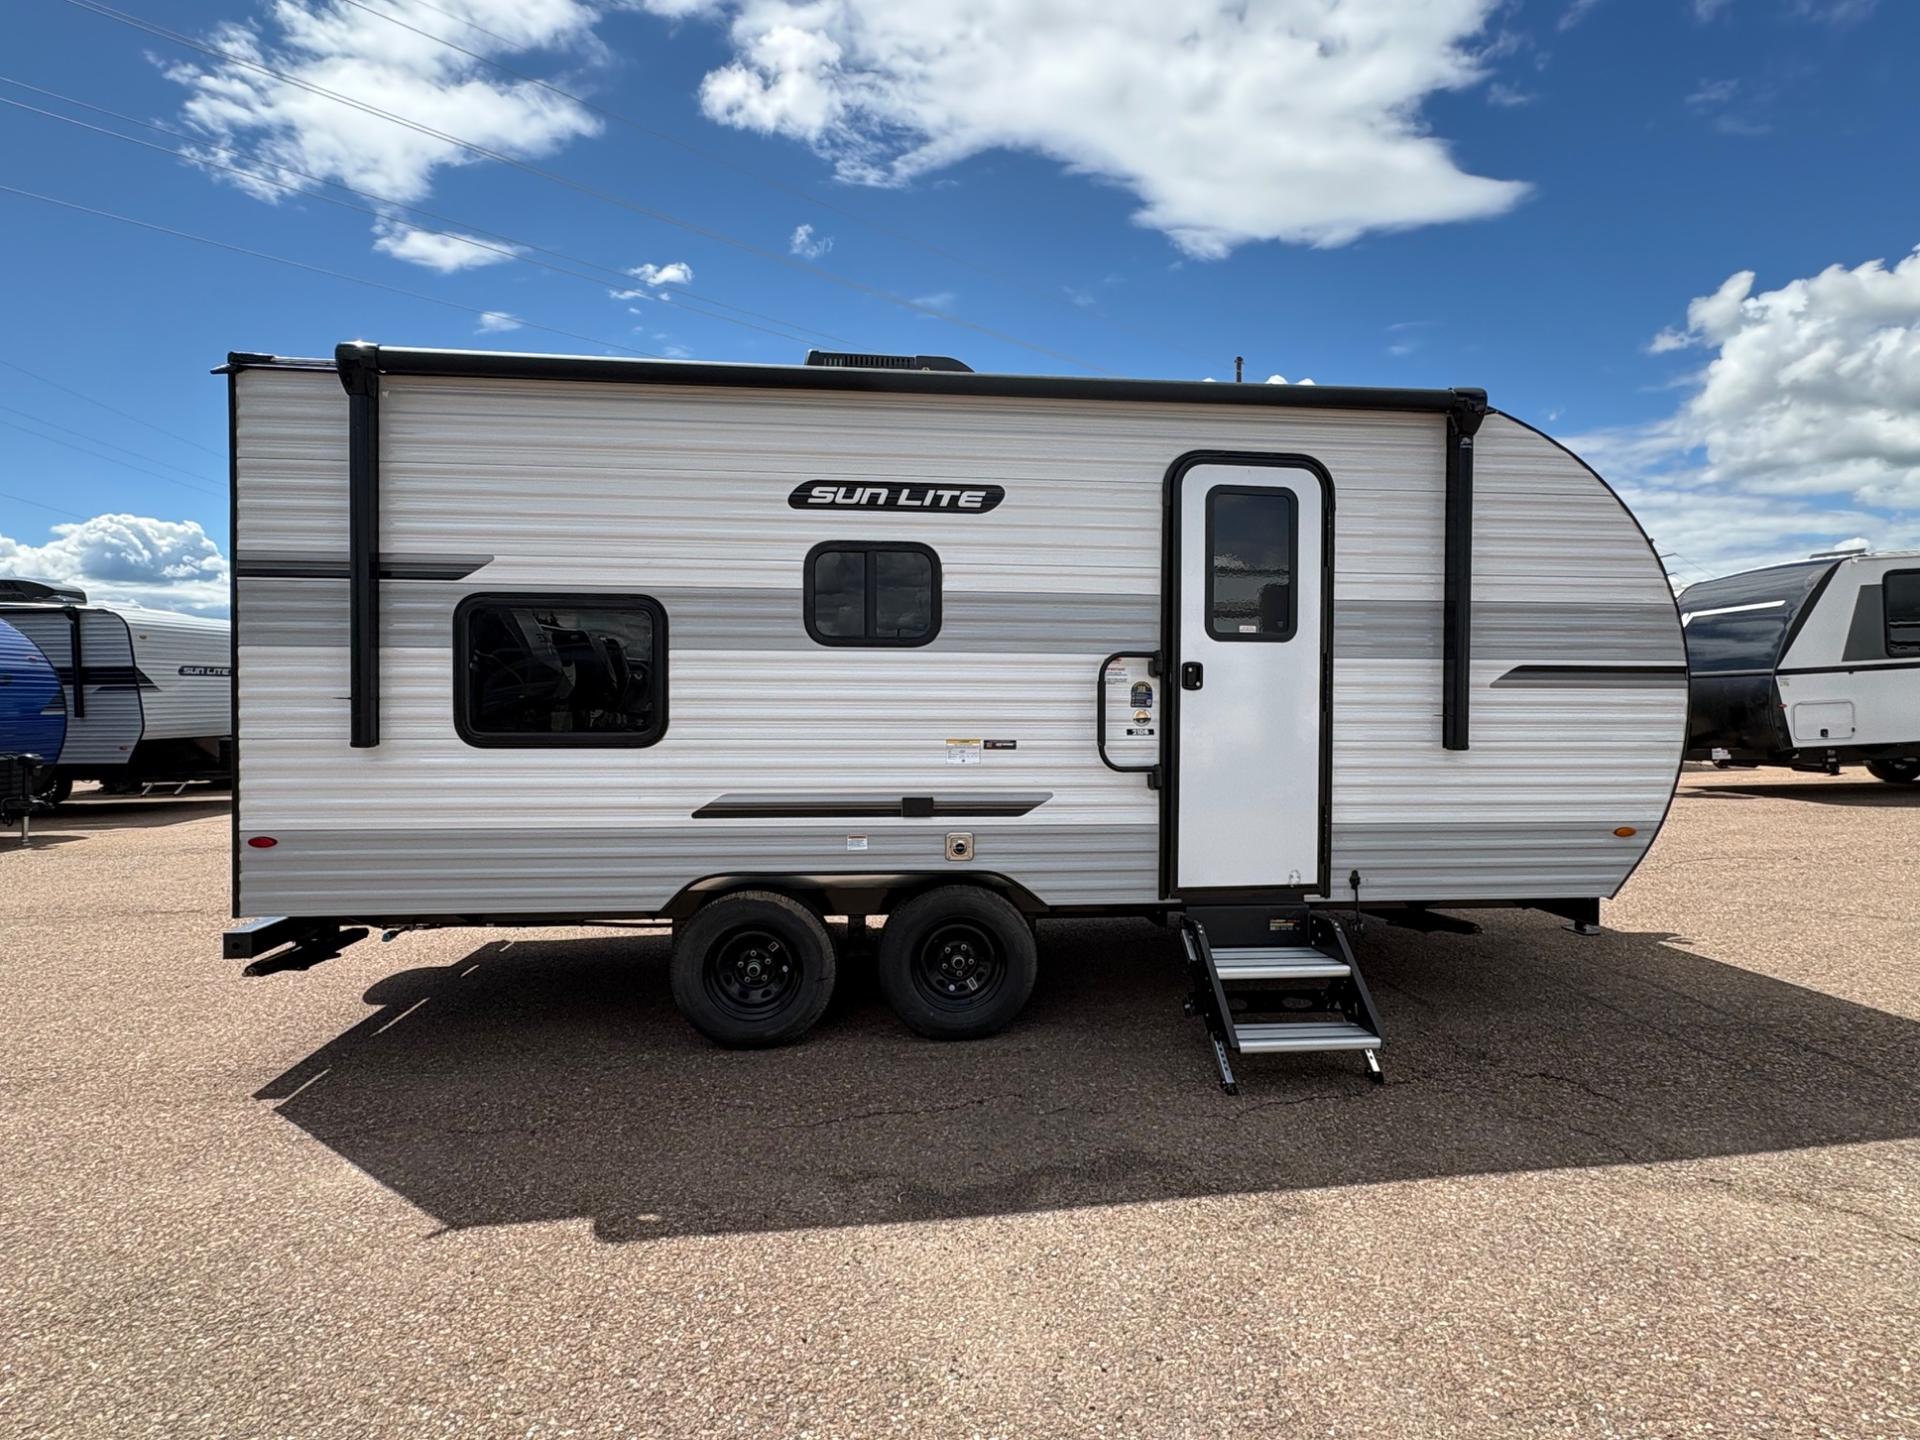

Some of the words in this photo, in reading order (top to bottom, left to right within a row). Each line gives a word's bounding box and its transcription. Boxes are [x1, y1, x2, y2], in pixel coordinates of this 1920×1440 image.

[807, 486, 889, 505] SUN
[896, 488, 987, 508] LITE
[183, 667, 204, 675] SUN
[207, 668, 230, 676] LITE
